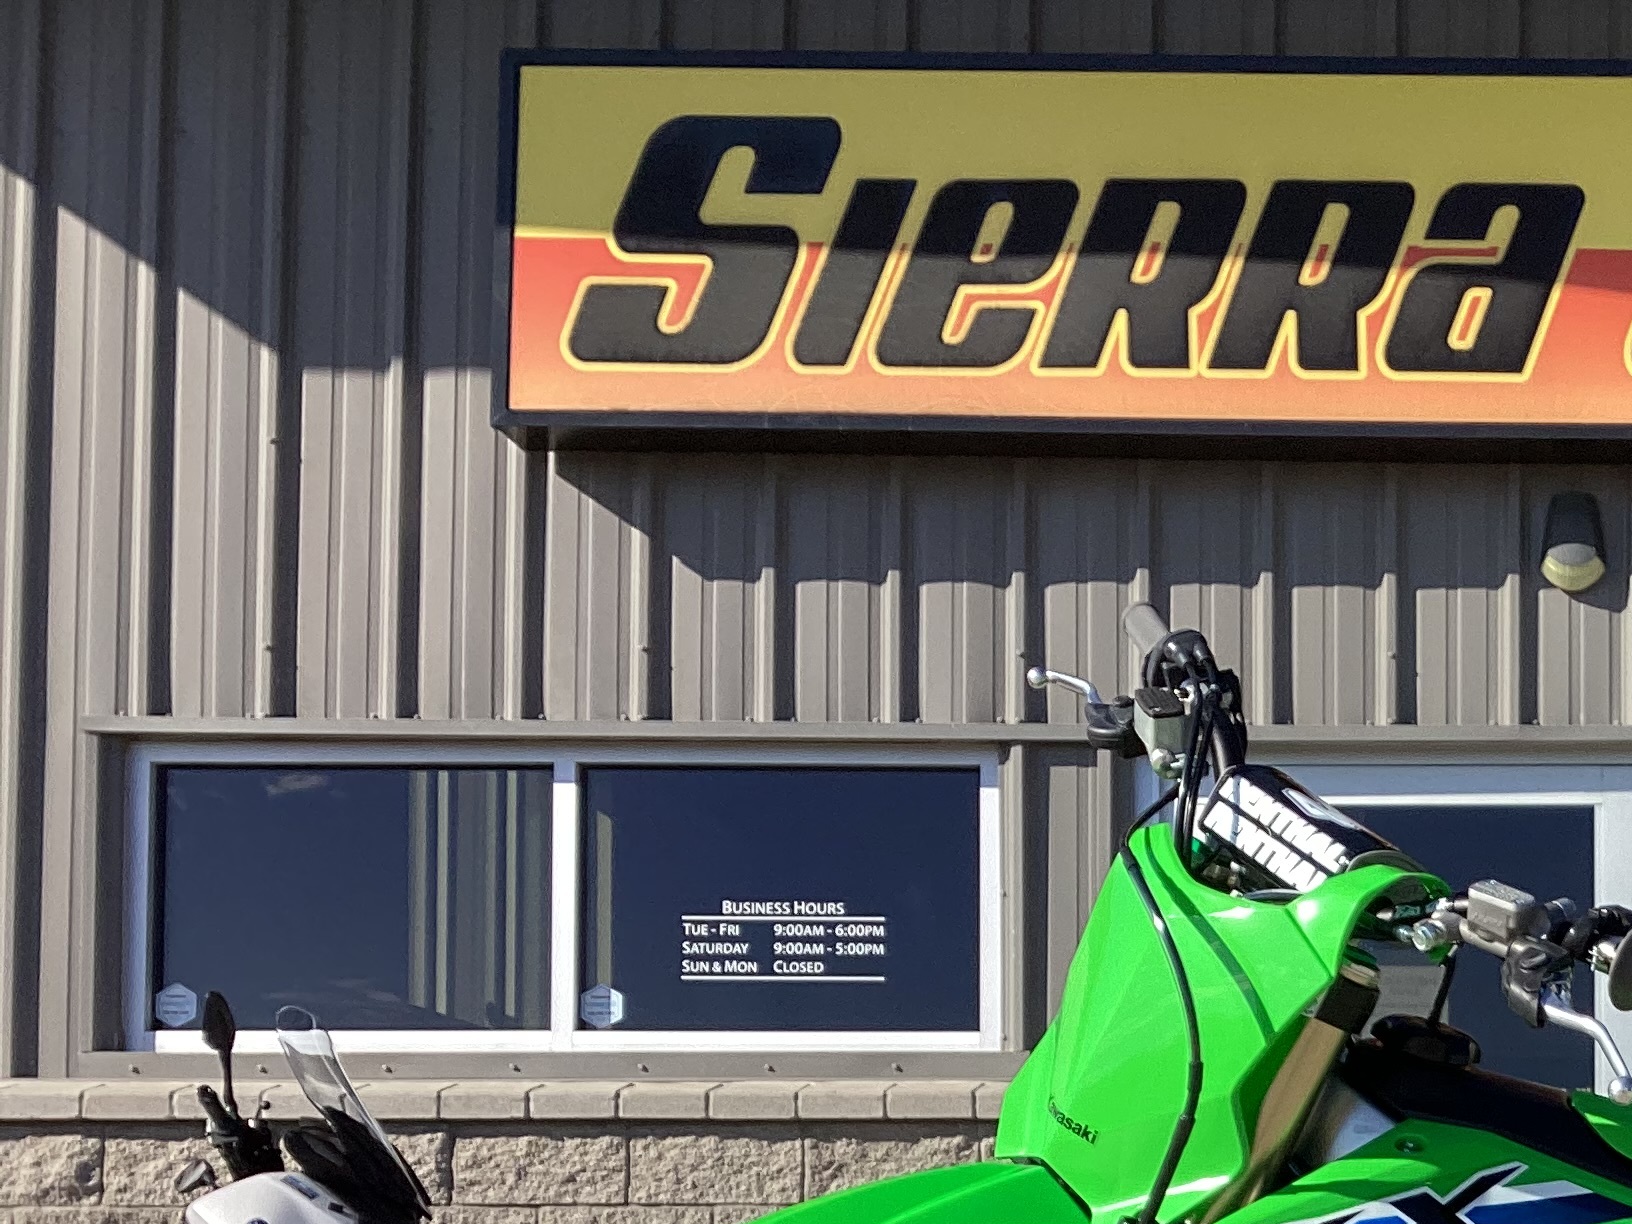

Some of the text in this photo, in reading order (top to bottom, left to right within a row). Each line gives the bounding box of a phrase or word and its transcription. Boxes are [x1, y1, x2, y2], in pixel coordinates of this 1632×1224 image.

[563, 113, 1586, 380] Sierra
[721, 899, 845, 915] BUSINESS HOURS
[682, 922, 709, 936] TUE
[719, 922, 740, 936] FRI
[773, 923, 825, 937] 9:00AM
[834, 923, 885, 937] 6:00PM
[681, 941, 749, 955] SATURDAY
[773, 941, 825, 955] 9:00AM
[835, 942, 885, 955] 5:00PM
[681, 959, 825, 974] SUN & MON CLOSED
